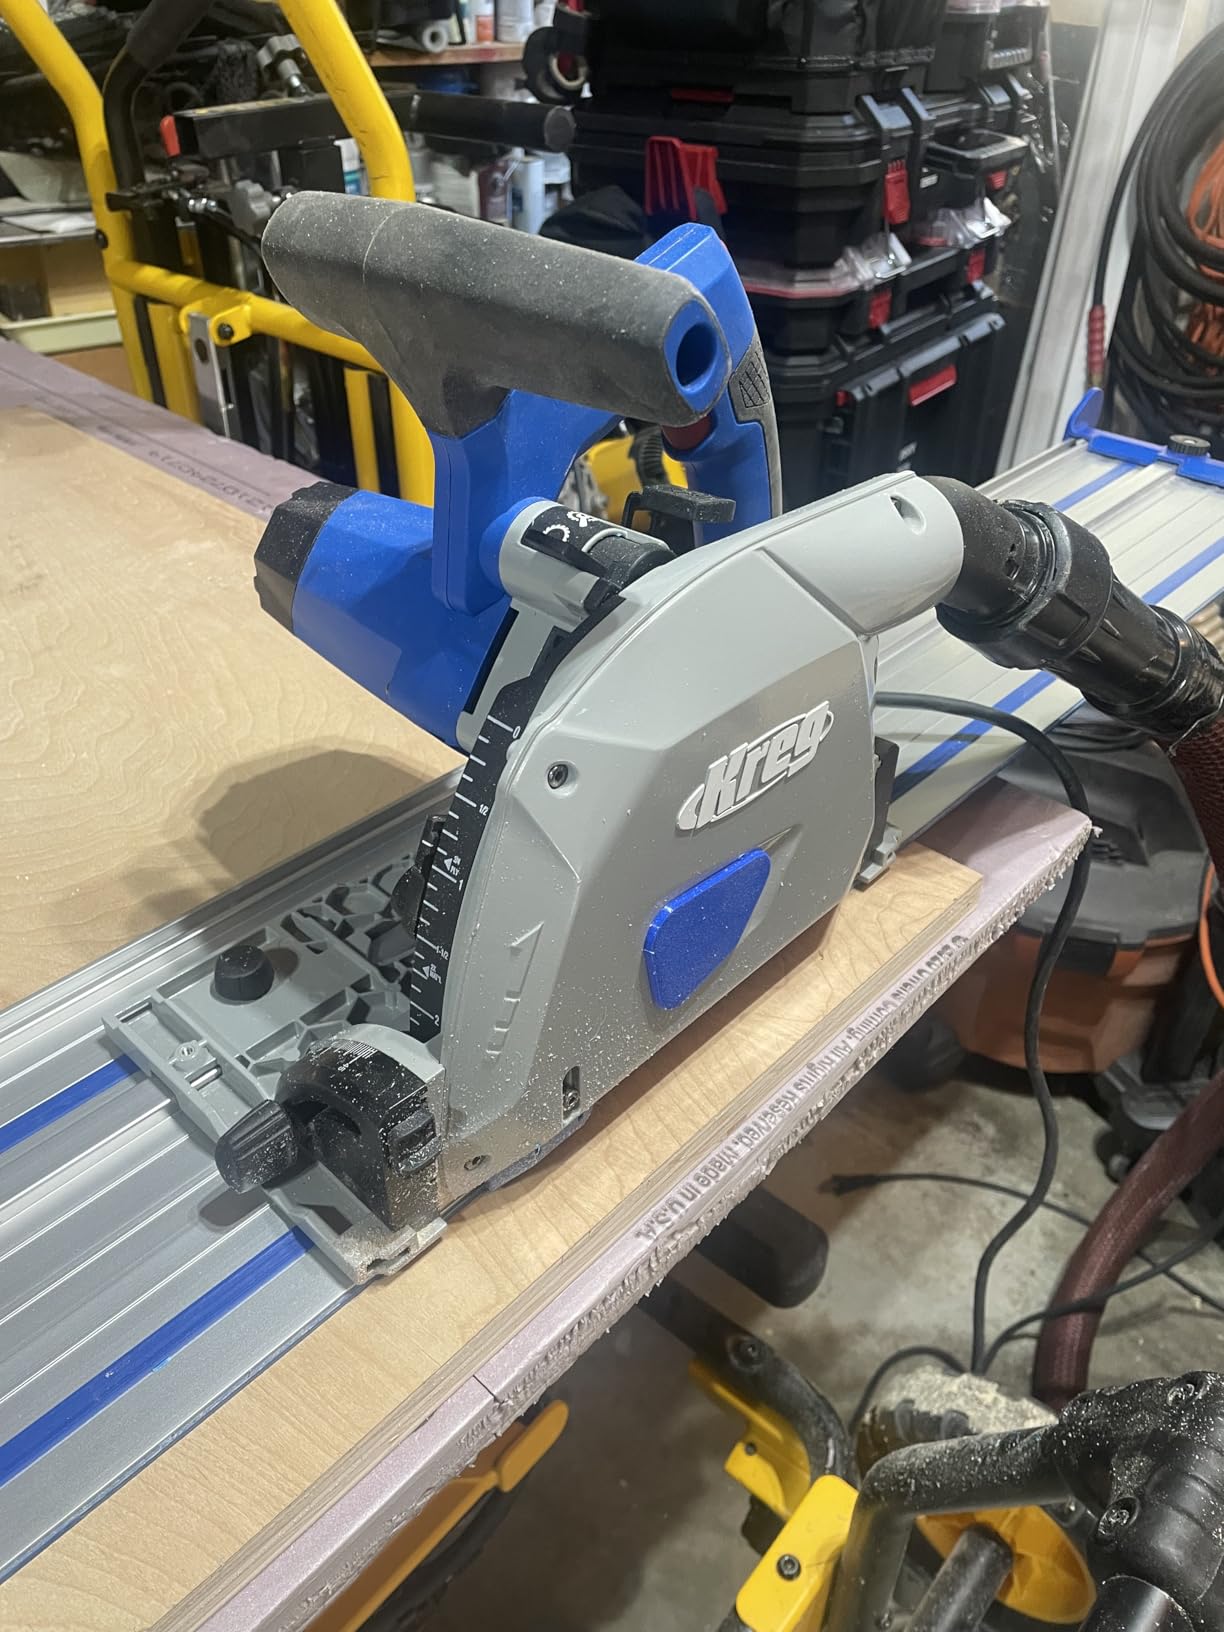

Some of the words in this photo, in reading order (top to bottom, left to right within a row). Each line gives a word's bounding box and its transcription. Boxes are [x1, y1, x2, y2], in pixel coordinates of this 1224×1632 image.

[512, 725, 521, 739] 0
[697, 700, 831, 829] Kreg
[479, 803, 489, 816] 1/2
[458, 879, 464, 891] 1
[436, 945, 449, 960] 1-1/2
[434, 1014, 440, 1027] 2
[829, 1038, 854, 1062] All
[730, 1086, 802, 1156] Reserved.
[691, 1143, 742, 1191] Made
[631, 1193, 689, 1245] U.S.A.
